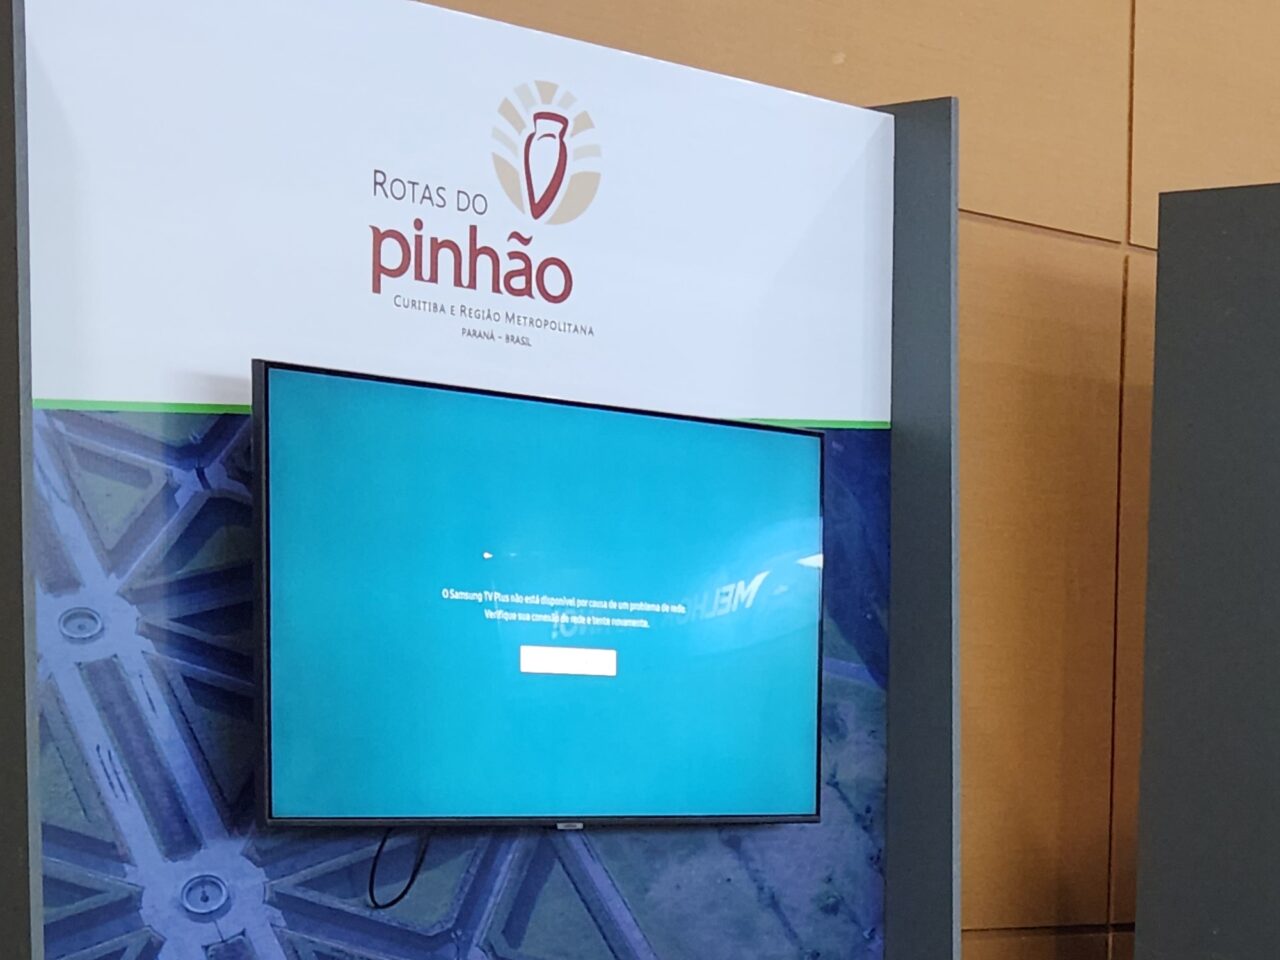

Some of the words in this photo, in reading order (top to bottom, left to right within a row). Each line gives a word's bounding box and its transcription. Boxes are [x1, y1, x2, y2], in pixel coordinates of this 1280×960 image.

[373, 169, 447, 208] ROTAS
[456, 190, 488, 215] DO
[368, 218, 573, 304] pinhão
[394, 295, 446, 315] CURITIBA
[450, 304, 456, 316] E
[460, 305, 501, 322] REGIÃO
[505, 311, 595, 336] METROPOLITANA
[461, 327, 495, 342] PARANÁ
[505, 334, 532, 347] BRASIL
[449, 589, 482, 602] Samsung
[483, 591, 494, 601] TV
[494, 592, 509, 603] Plus
